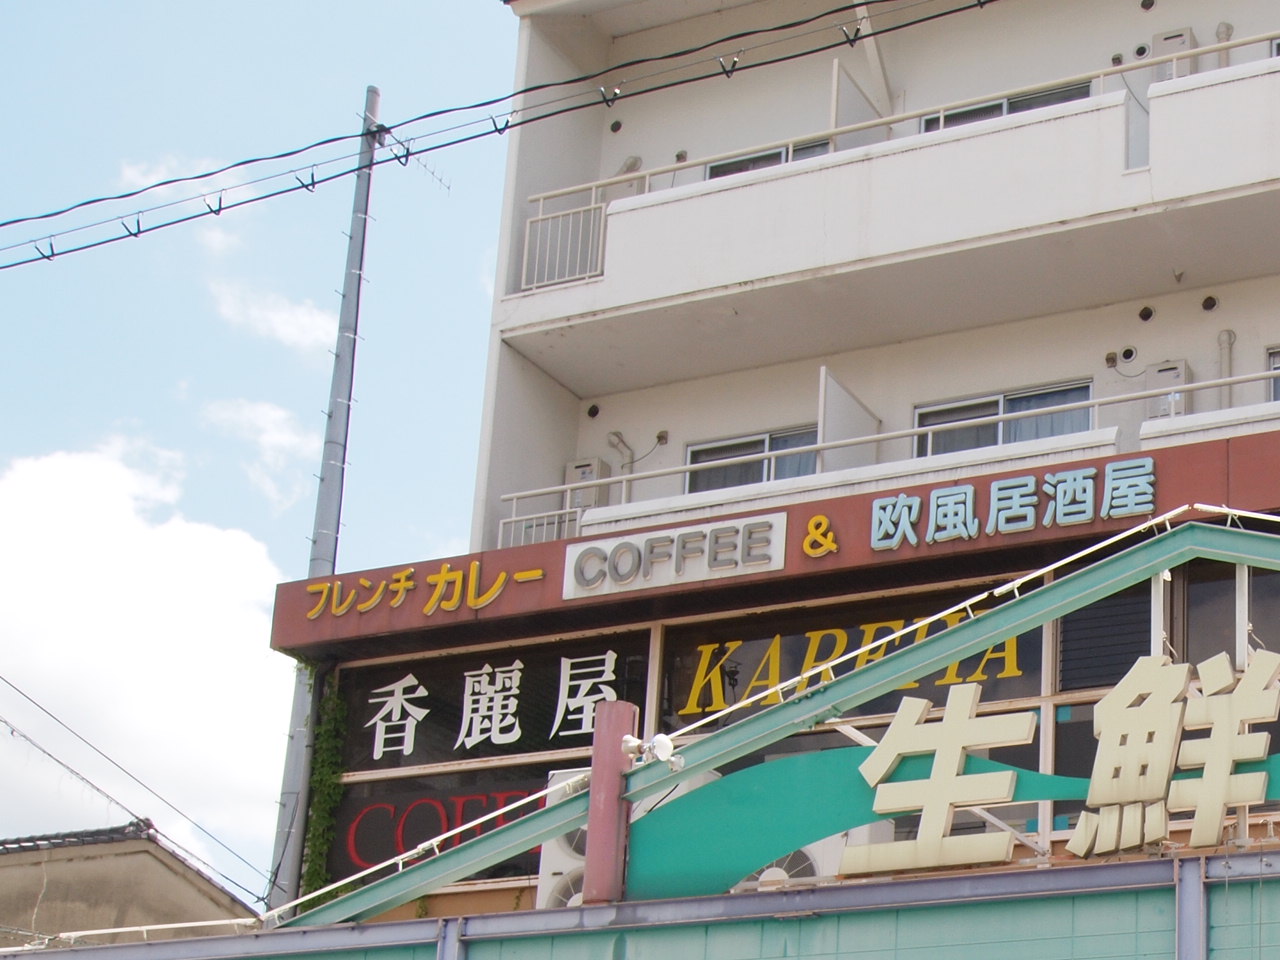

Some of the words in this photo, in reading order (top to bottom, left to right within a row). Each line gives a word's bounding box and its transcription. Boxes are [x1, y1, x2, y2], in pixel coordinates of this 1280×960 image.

[871, 456, 1157, 551] 欧風居酒屋
[573, 521, 774, 590] COFFEE
[802, 514, 838, 558] &
[363, 650, 618, 761] 香麗屋
